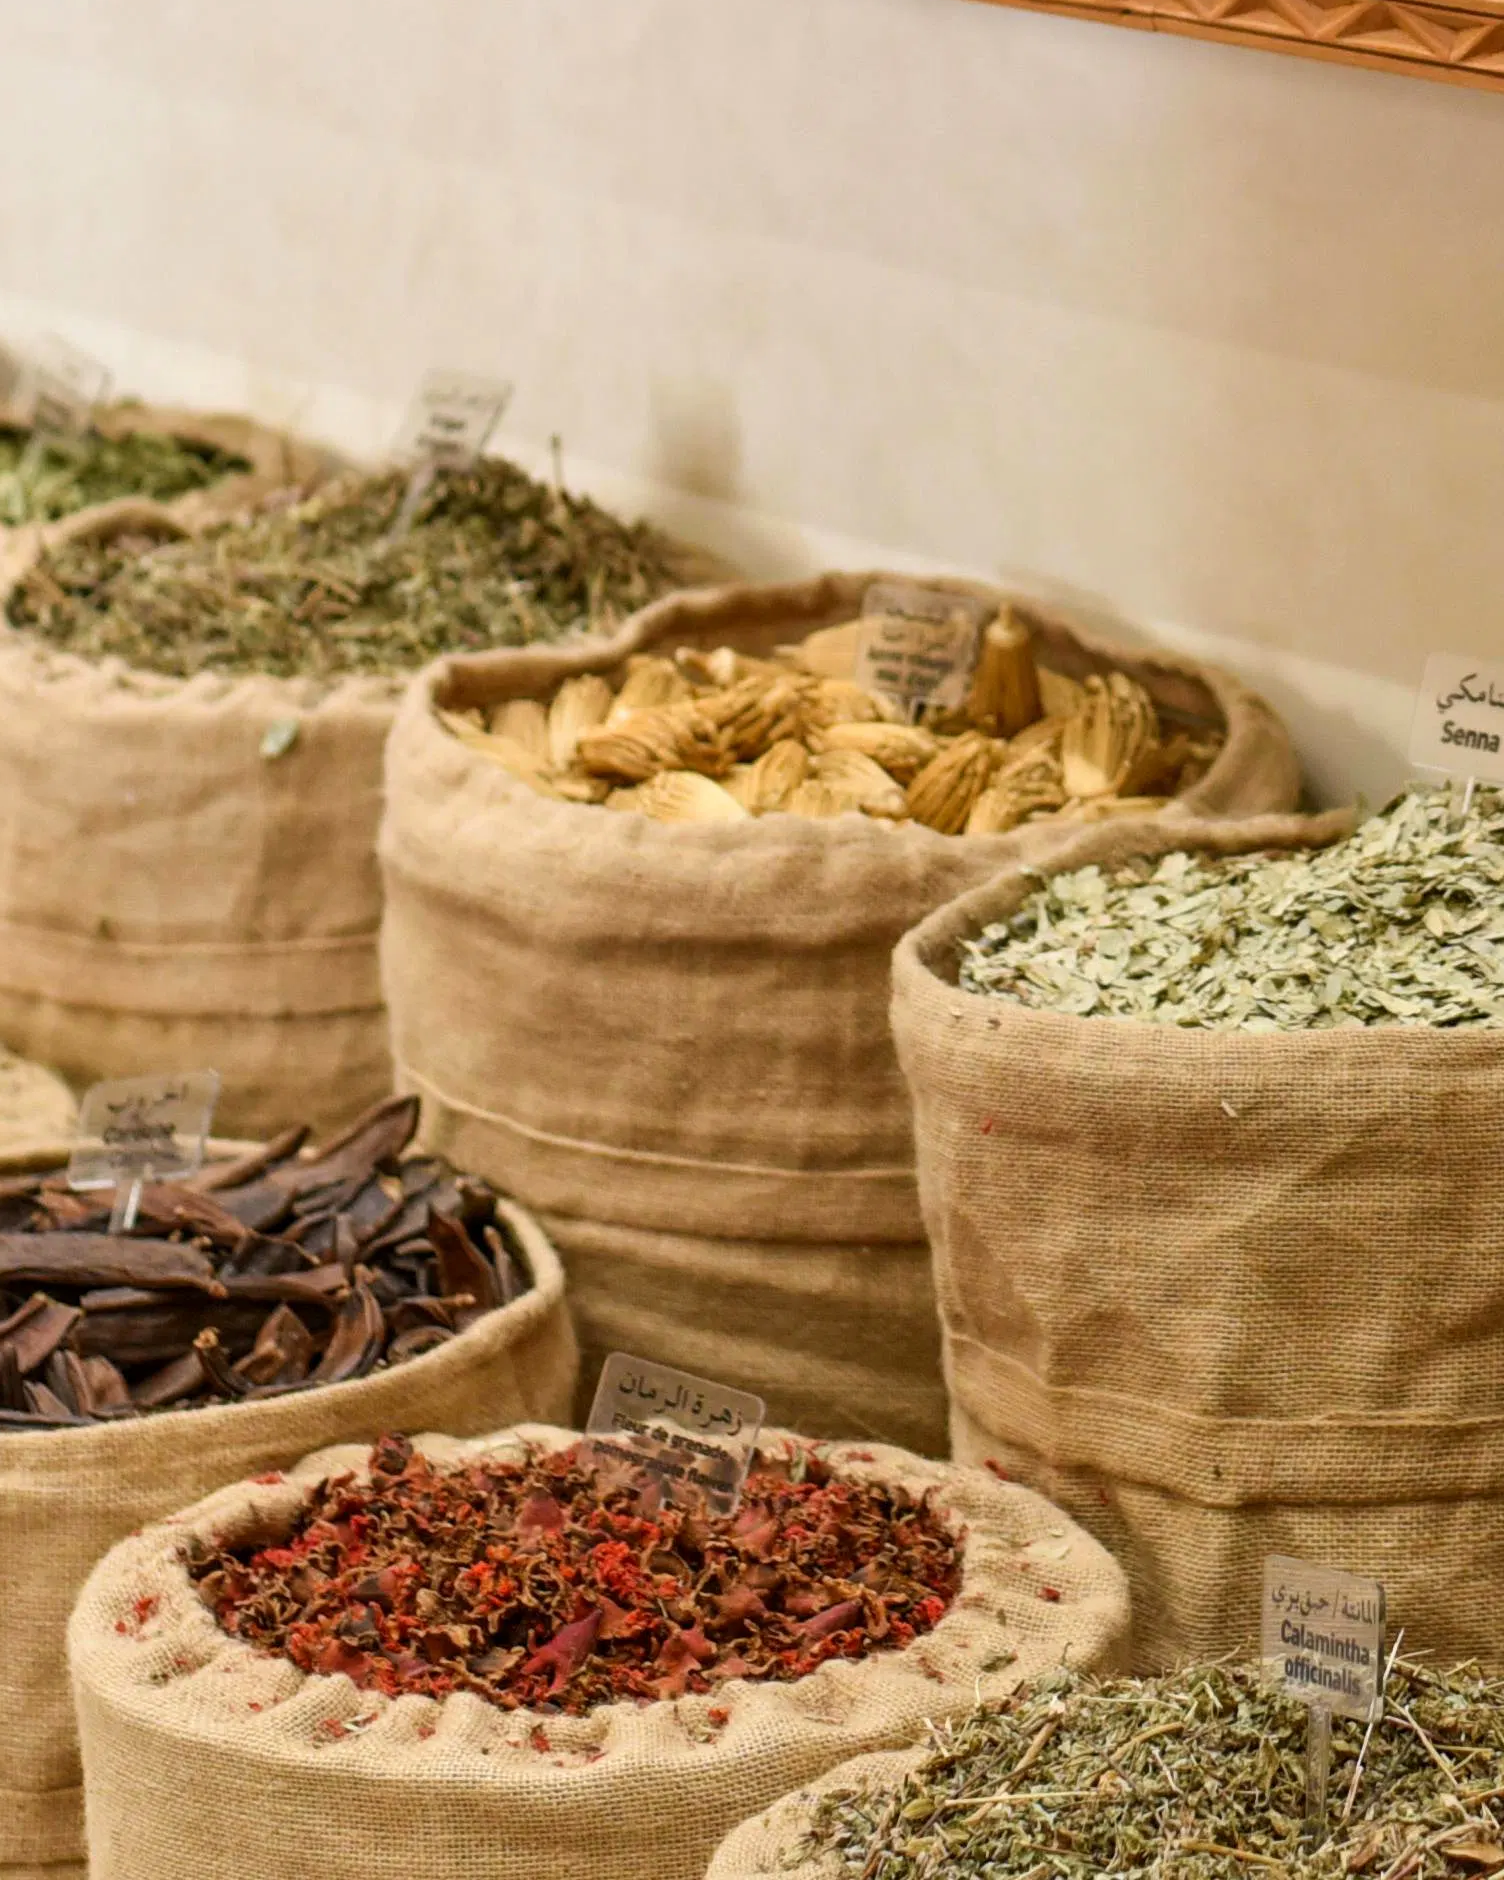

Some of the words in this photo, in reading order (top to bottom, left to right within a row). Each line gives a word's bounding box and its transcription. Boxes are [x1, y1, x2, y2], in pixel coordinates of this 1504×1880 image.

[1440, 720, 1501, 753] Senna
[618, 1370, 689, 1418] الرمان
[692, 1395, 743, 1436] زهرة
[612, 1413, 649, 1438] Fleur
[652, 1426, 668, 1443] de
[671, 1432, 729, 1461] grenade
[1280, 1618, 1370, 1666] Calamintha
[1284, 1655, 1361, 1695] officinalis
